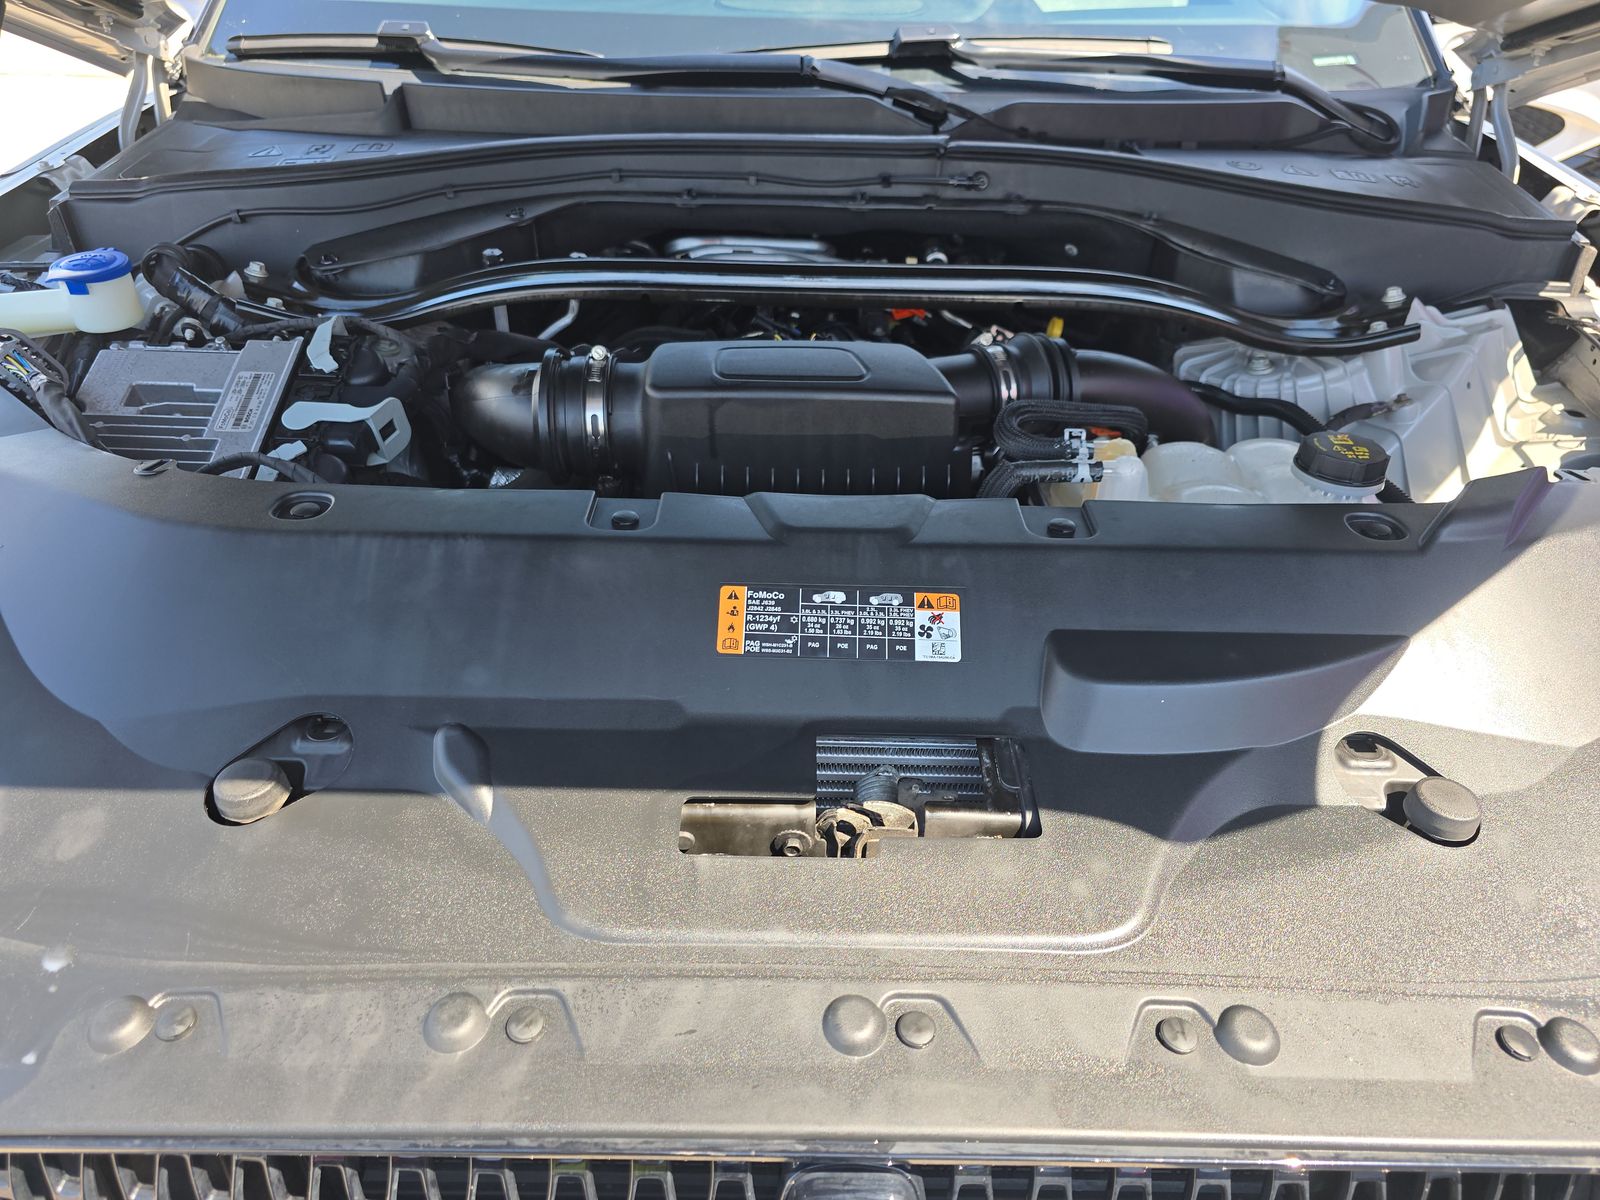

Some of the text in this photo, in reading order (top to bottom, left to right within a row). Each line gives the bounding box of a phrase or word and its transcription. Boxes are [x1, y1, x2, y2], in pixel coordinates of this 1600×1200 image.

[747, 590, 785, 599] FoMoCo
[747, 614, 781, 623] R-1234yf
[770, 624, 778, 632] 4)
